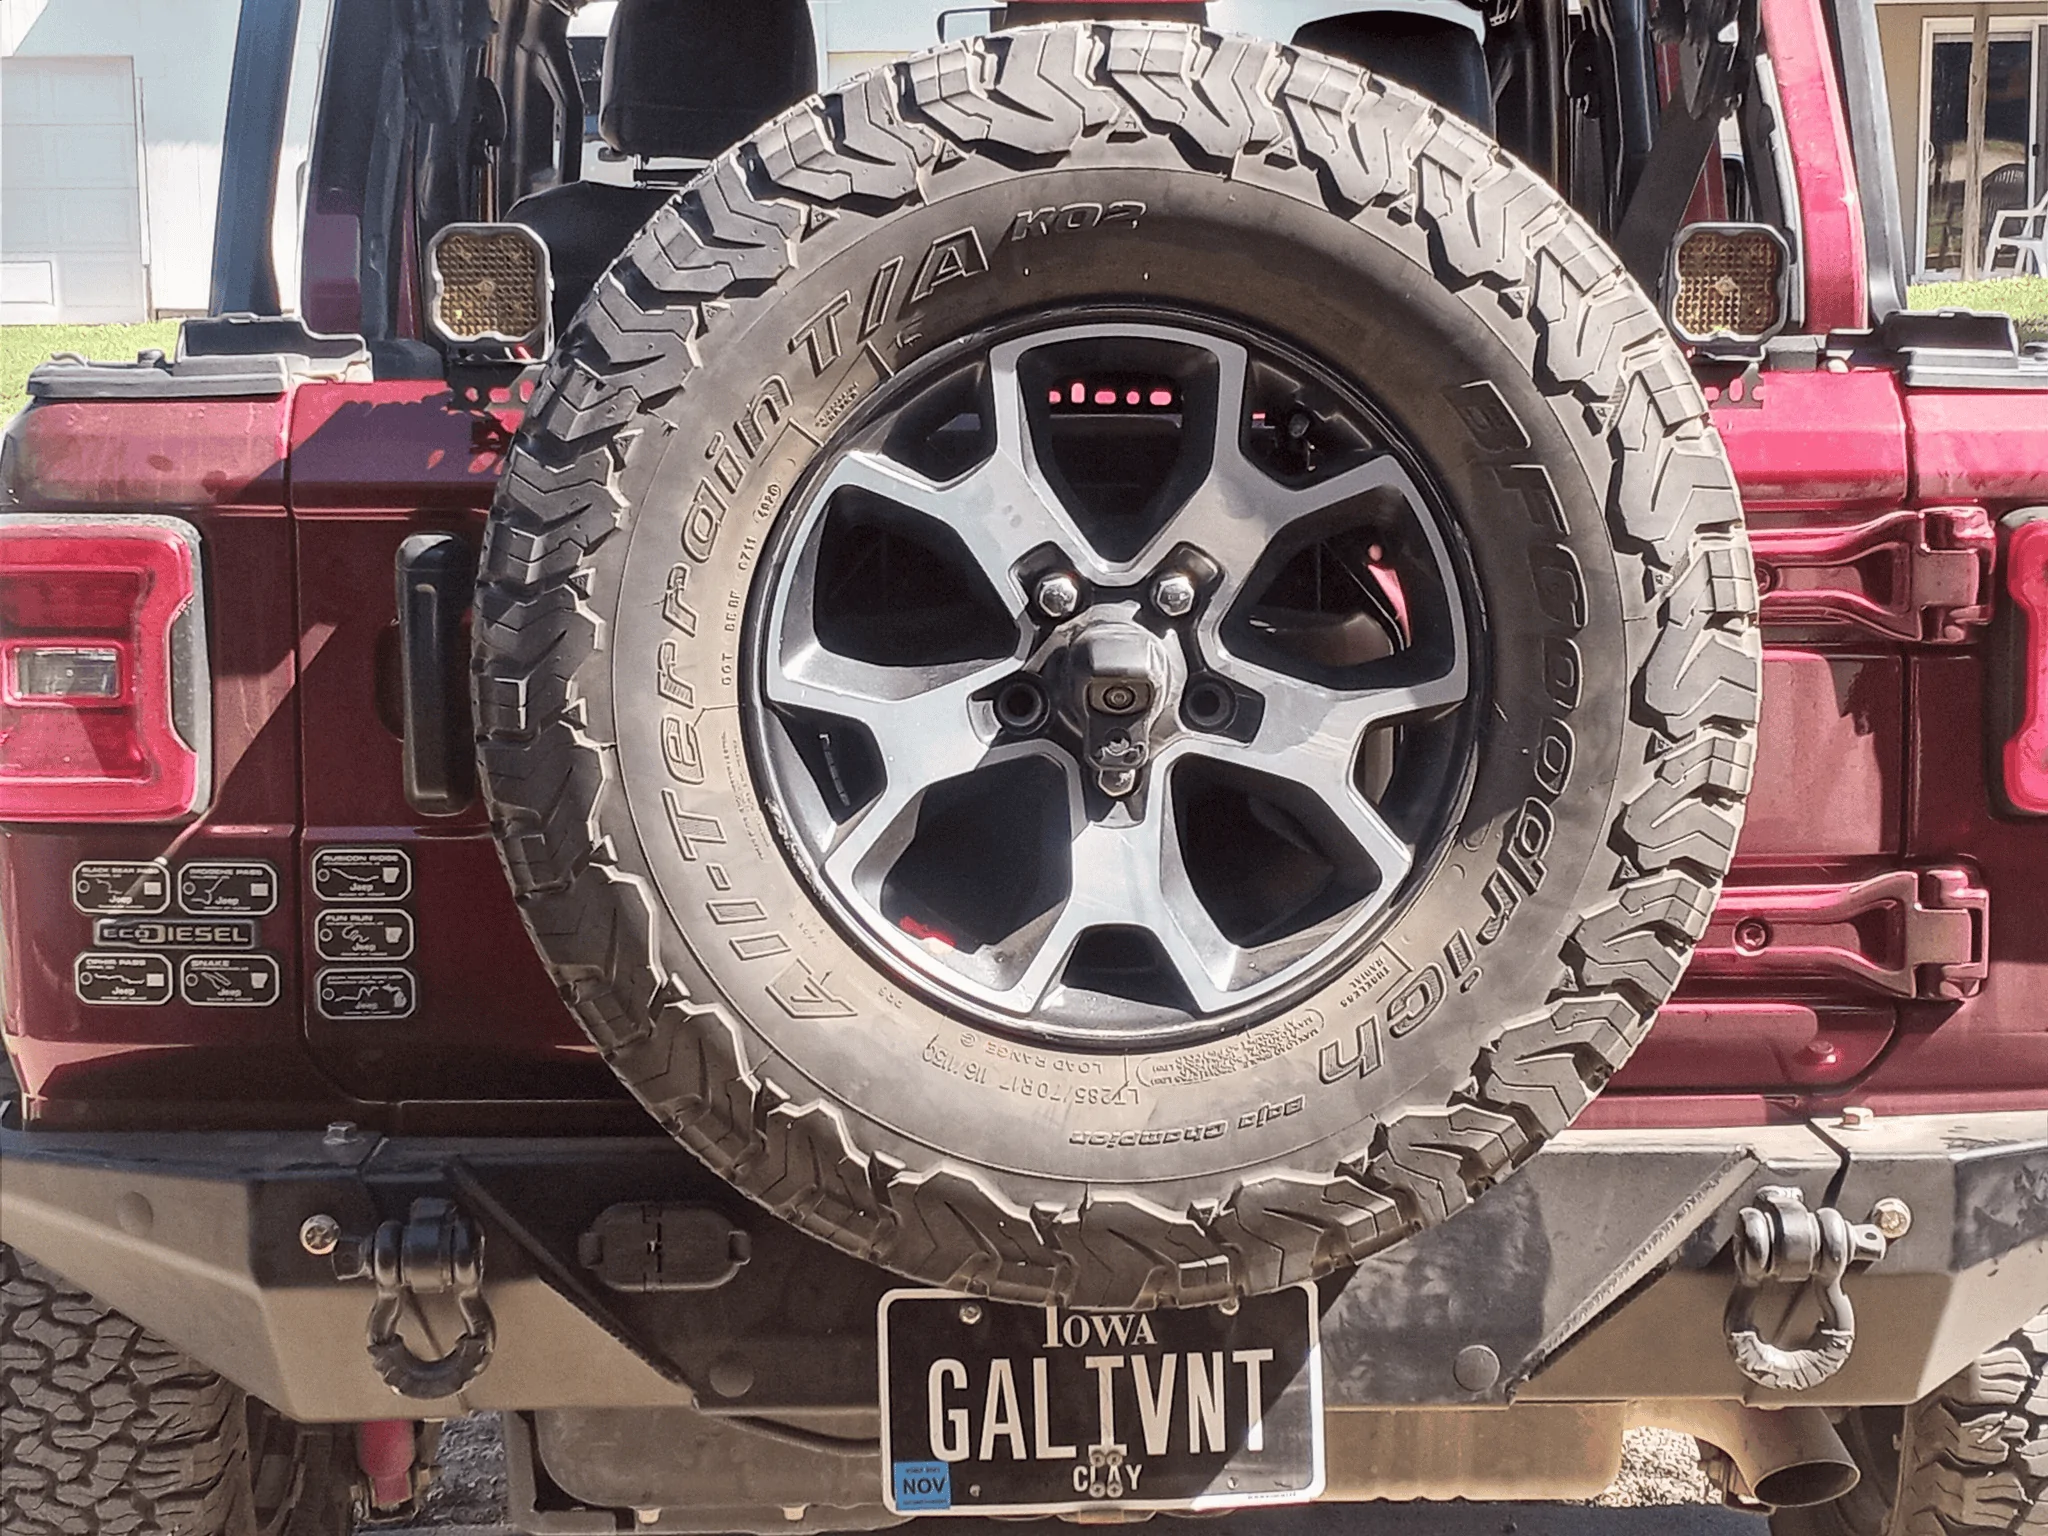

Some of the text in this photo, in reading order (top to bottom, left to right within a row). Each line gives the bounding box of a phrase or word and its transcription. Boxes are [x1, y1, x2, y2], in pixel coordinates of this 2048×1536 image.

[1011, 201, 1147, 243] KO2
[1318, 379, 1589, 1085] BFGoodrich
[984, 1041, 1047, 1069] RANGE
[1052, 1060, 1103, 1075] LOAD
[903, 1477, 946, 1495] NOV
